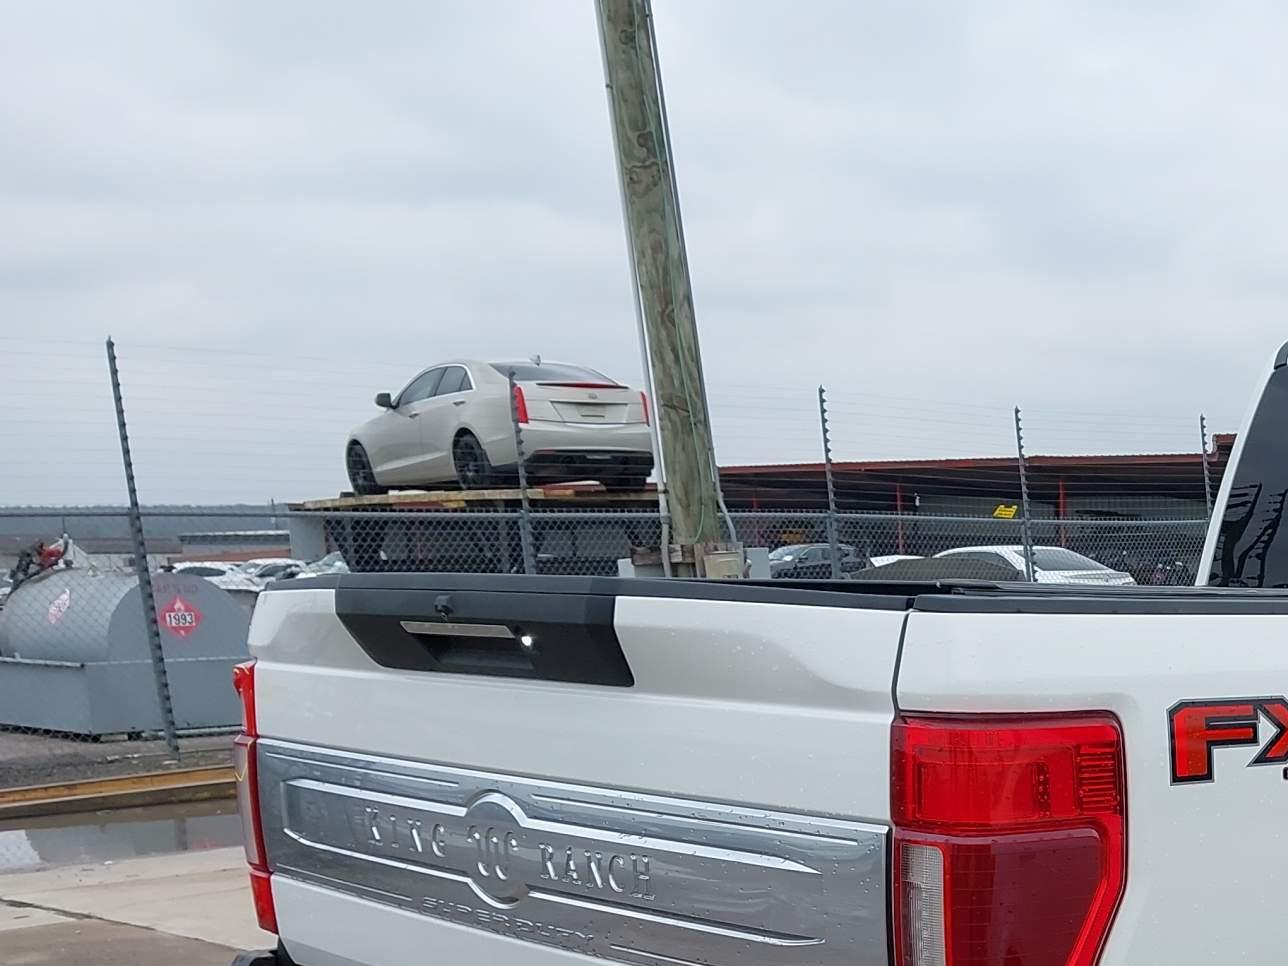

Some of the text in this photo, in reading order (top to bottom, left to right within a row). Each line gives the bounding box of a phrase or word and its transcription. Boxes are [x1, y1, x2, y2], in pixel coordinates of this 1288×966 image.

[167, 613, 194, 625] 1993
[364, 806, 656, 901] KING RANCH
